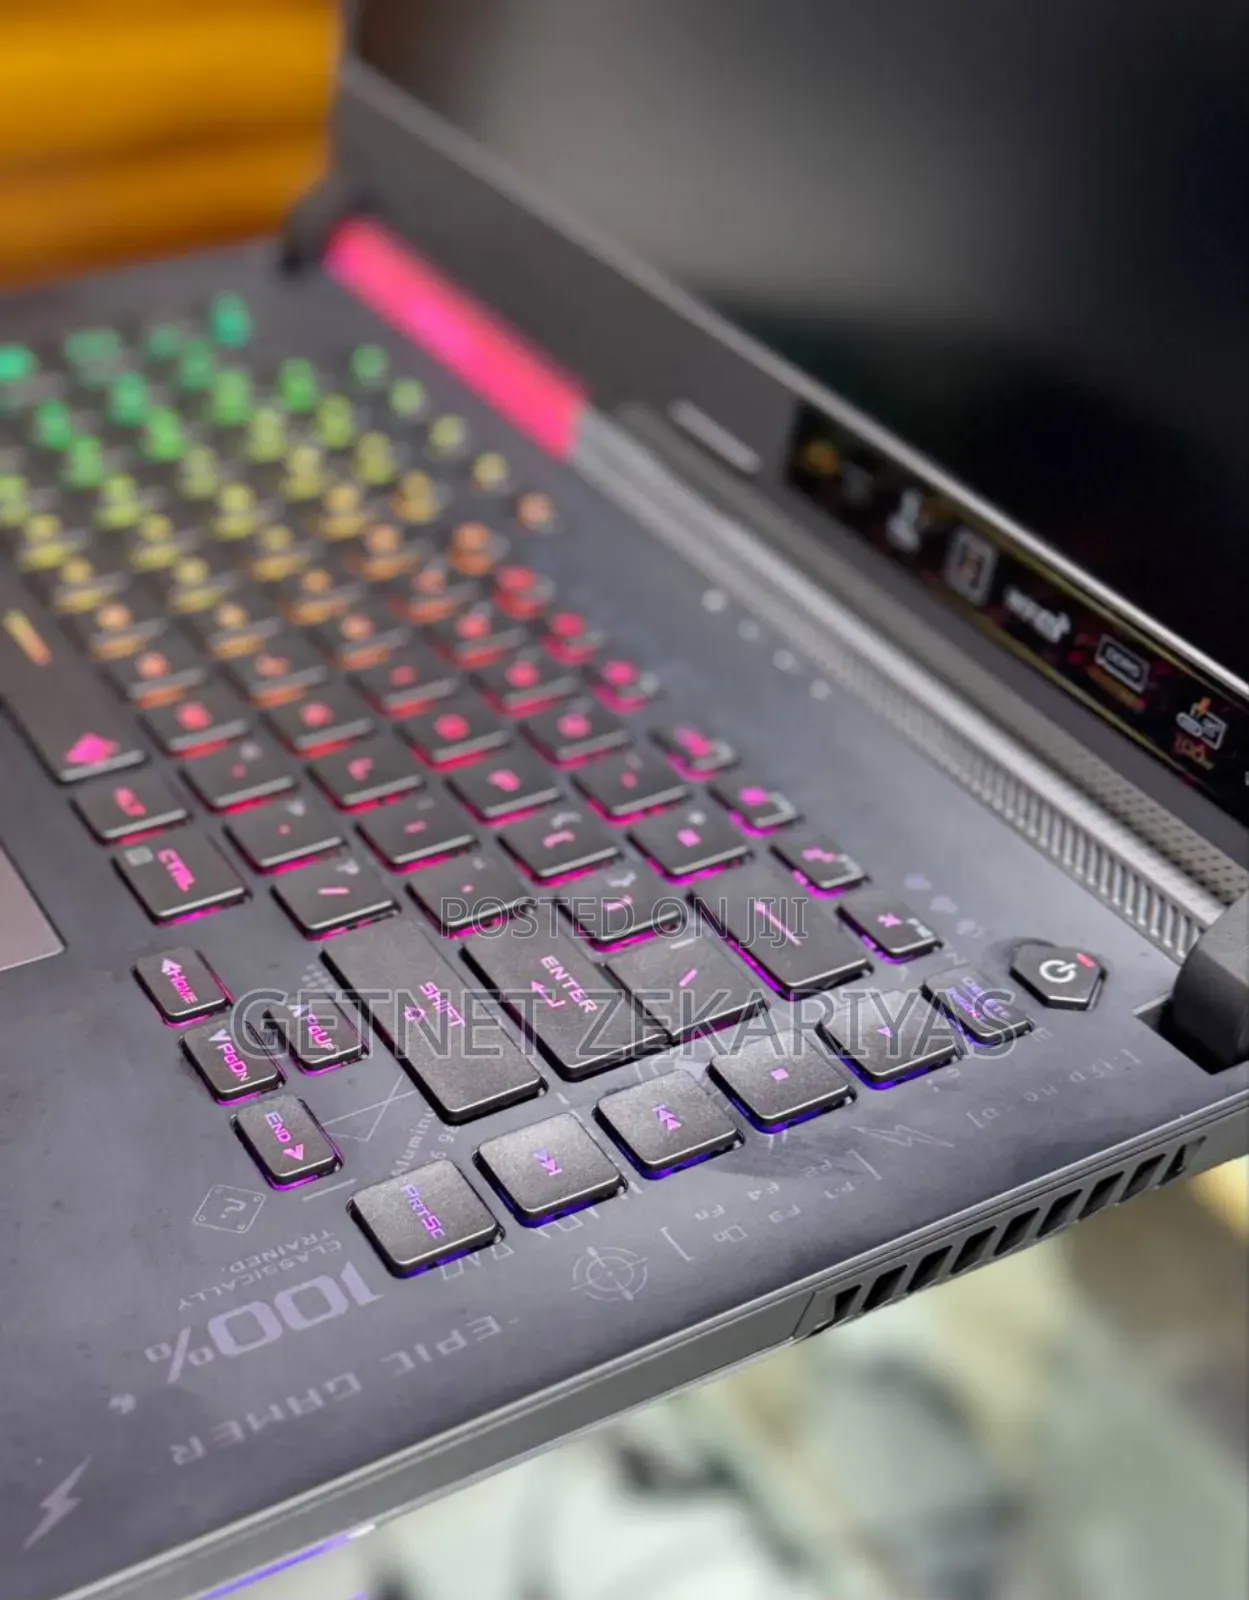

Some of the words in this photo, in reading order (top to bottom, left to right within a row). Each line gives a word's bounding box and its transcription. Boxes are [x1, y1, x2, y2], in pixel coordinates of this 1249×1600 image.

[418, 981, 466, 1028] SHIFT
[540, 954, 598, 1014] ENTER
[265, 1110, 292, 1143] END
[178, 1239, 342, 1311] CLASSICALLY
[144, 1259, 386, 1384] 100%
[379, 1314, 502, 1377] EPIC
[168, 1371, 362, 1466] GAMER
